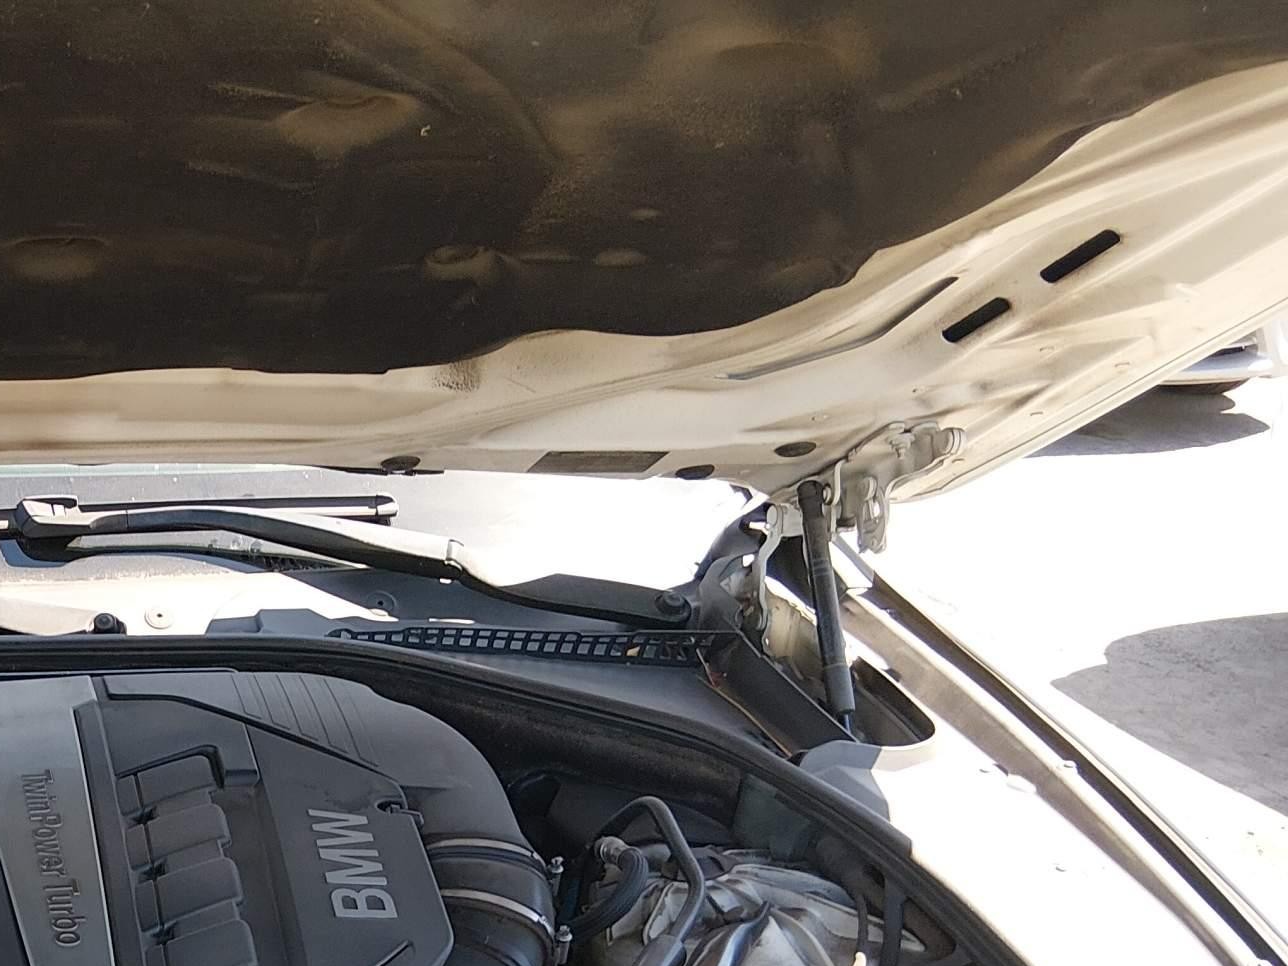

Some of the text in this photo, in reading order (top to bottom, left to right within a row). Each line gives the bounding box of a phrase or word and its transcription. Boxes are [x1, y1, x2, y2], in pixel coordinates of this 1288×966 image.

[21, 769, 87, 947] TwinPower Turbo
[308, 809, 398, 918] BMW
